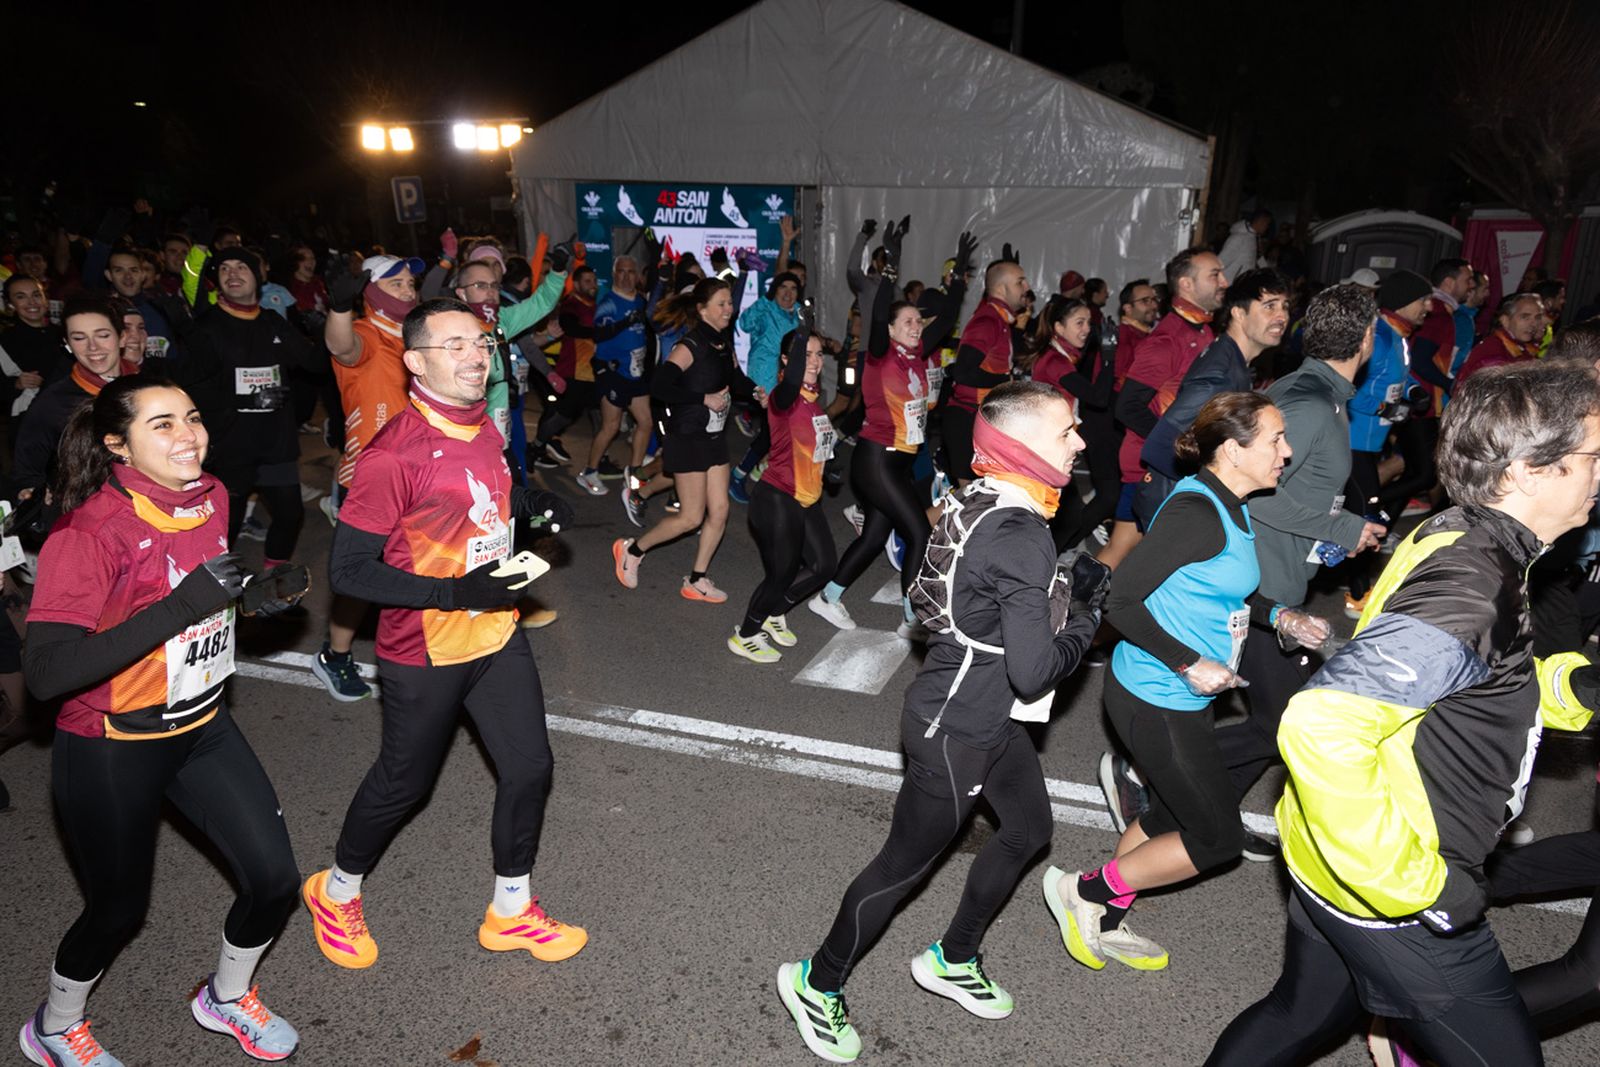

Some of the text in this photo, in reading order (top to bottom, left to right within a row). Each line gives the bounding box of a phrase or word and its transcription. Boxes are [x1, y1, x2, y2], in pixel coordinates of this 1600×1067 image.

[657, 190, 710, 208] 43 SAN
[653, 204, 708, 225] ANTÓN
[1144, 472, 1153, 483] 6
[179, 628, 199, 643] SAN
[184, 625, 230, 667] 4482
